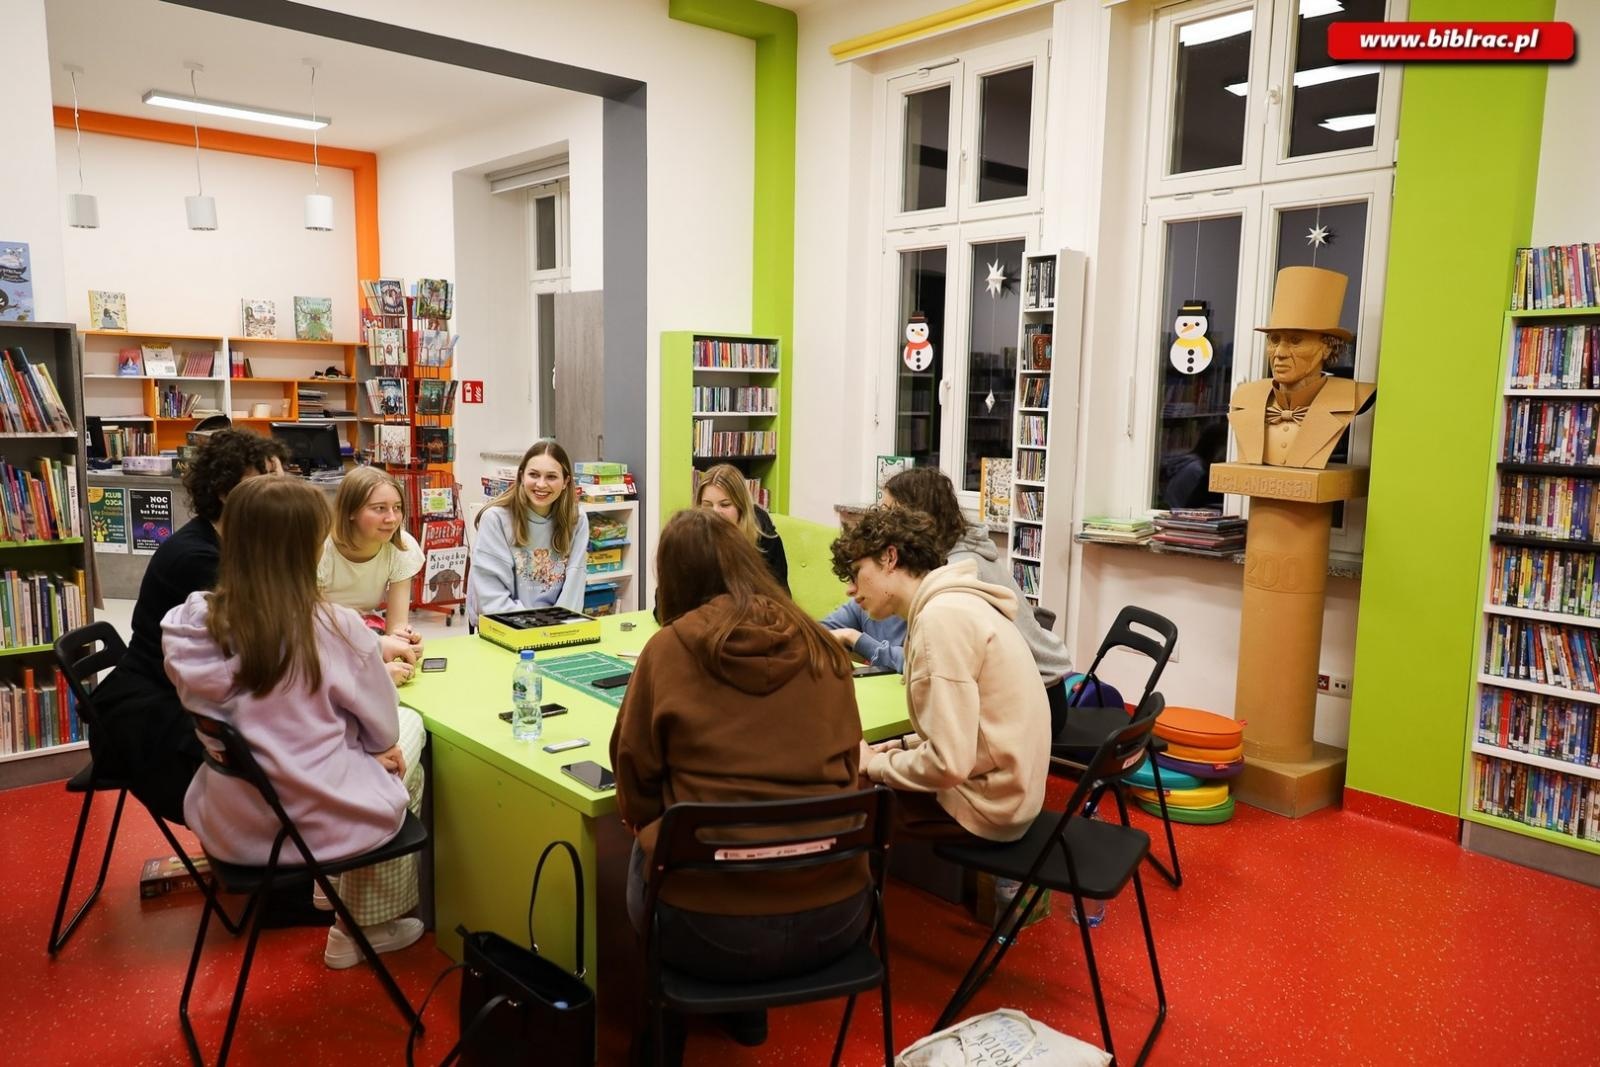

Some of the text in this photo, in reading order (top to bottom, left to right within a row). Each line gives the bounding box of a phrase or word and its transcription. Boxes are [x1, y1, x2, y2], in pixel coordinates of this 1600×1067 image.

[105, 491, 122, 499] KLUB
[430, 560, 464, 570] dla psa
